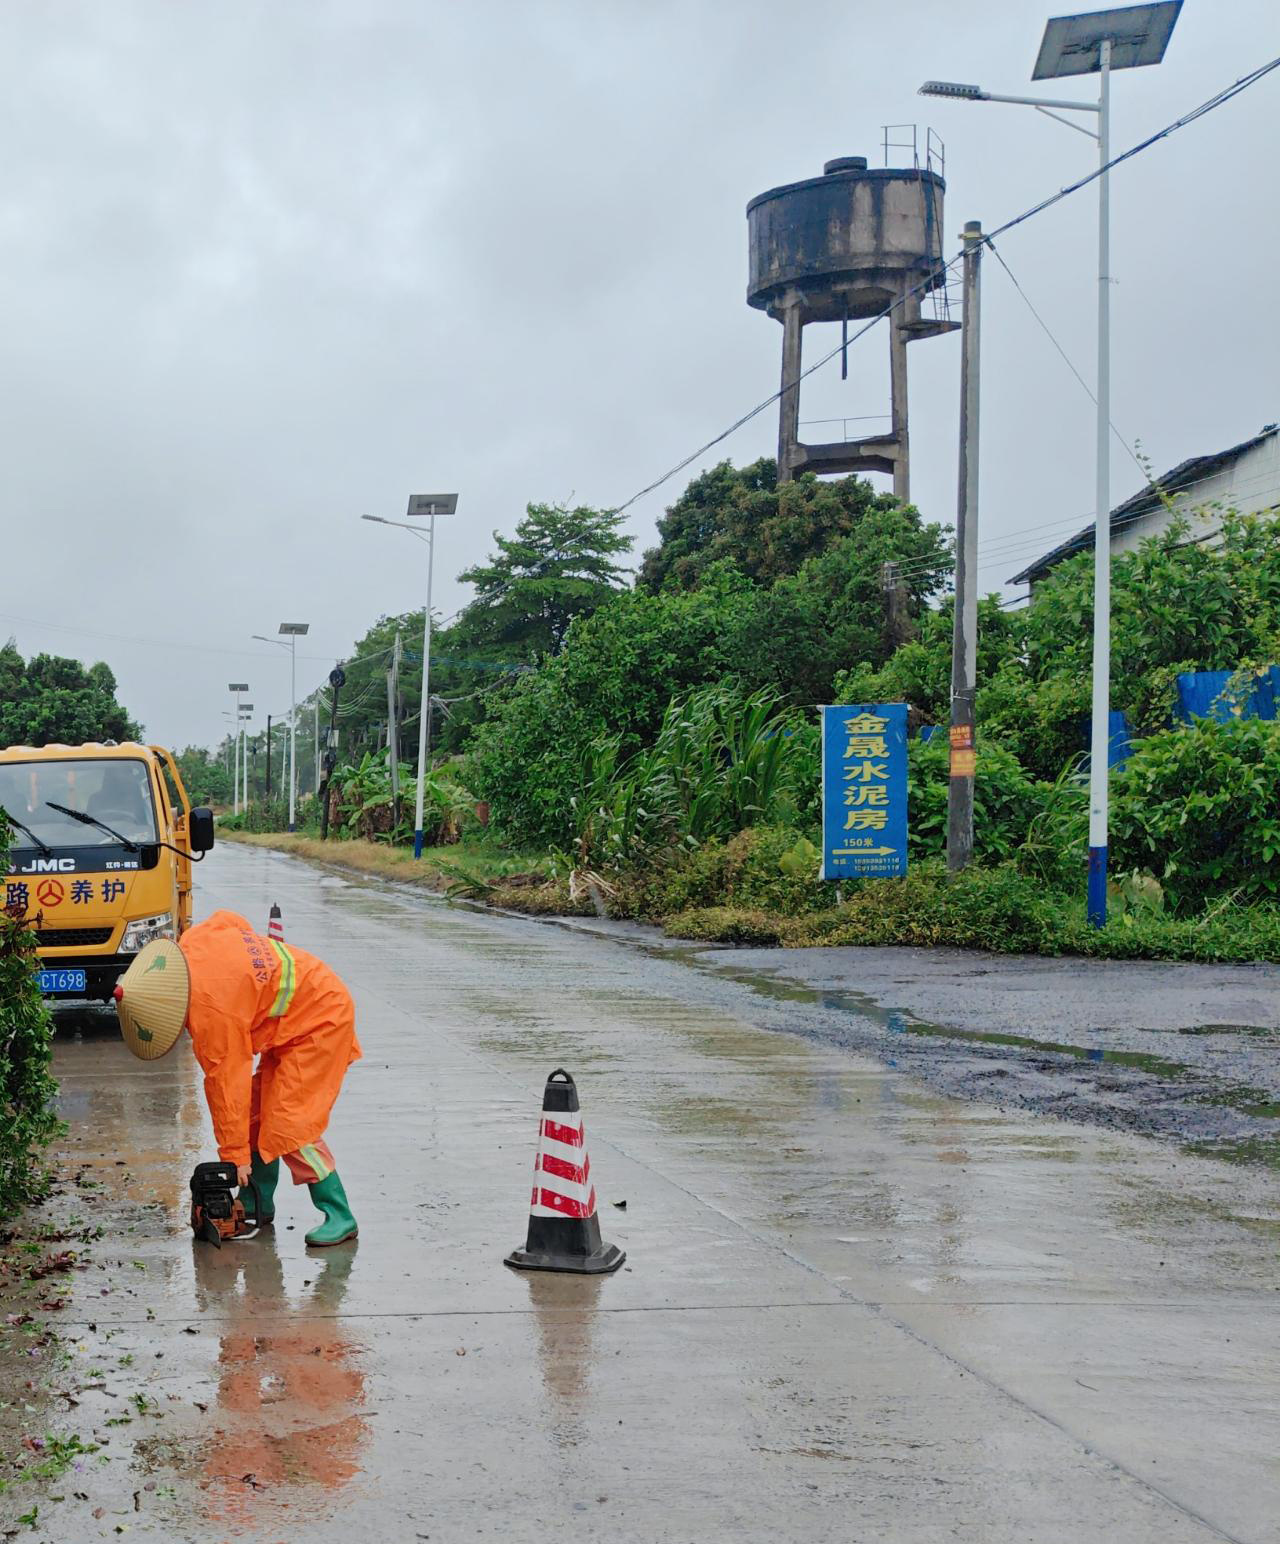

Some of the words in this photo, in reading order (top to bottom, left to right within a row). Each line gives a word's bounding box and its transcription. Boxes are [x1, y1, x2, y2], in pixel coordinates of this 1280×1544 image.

[843, 837, 874, 847] 150米
[21, 858, 76, 873] JMC
[70, 878, 126, 904] 养护
